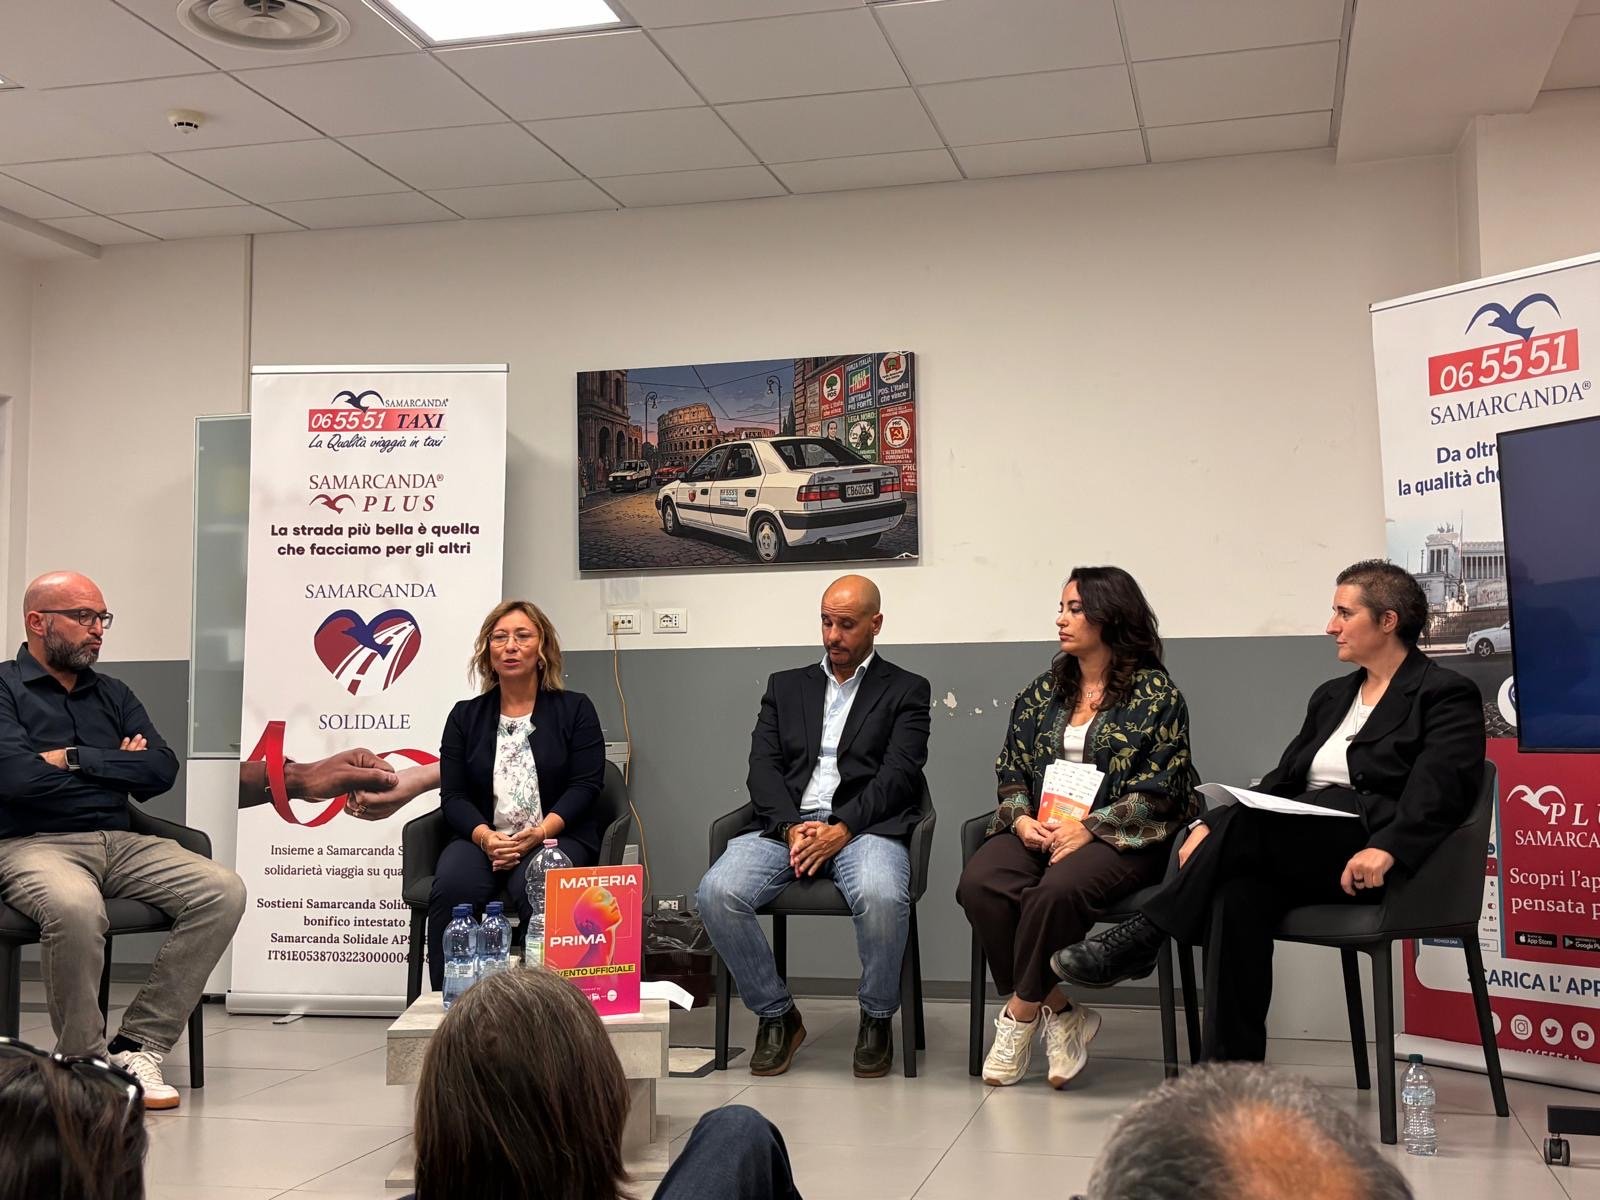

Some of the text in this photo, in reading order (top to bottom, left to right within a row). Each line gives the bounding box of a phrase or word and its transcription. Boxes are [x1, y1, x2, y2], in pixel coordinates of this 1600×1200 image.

[1440, 361, 1474, 391] 06
[311, 413, 332, 429] 06
[397, 413, 445, 429] TAXI
[308, 433, 446, 453] La Qualità viaggia in taxi
[1437, 441, 1499, 464] Da oltr
[1398, 478, 1411, 496] la
[1415, 469, 1472, 496] qualità
[362, 494, 436, 513] PLUS
[271, 522, 480, 539] La strada più bella è quella
[277, 542, 471, 557] che facciamo per gli altri
[305, 583, 437, 599] SAMARCANDA
[318, 714, 411, 730] SOLIDALE
[1547, 803, 1600, 826] PL
[1515, 829, 1600, 848] SAMARCA
[271, 845, 314, 856] Insieme
[317, 847, 324, 856] a
[326, 845, 395, 856] Samarcanda
[264, 865, 322, 876] solidarietà
[325, 866, 364, 879] viaggia
[367, 867, 380, 876] su
[1510, 867, 1564, 890] Scopri
[559, 874, 637, 889] MATERIA
[256, 898, 303, 909] Sostieni
[306, 899, 376, 910] Samarcanda
[1511, 897, 1586, 915] pensata
[303, 915, 351, 927] bonifico
[353, 916, 406, 928] intestato
[270, 932, 340, 944] Samarcanda
[342, 933, 389, 945] Solidale
[550, 933, 607, 948] PRIMA
[557, 965, 634, 977] VENTO UFFICIALE
[1468, 969, 1545, 992] ARICA
